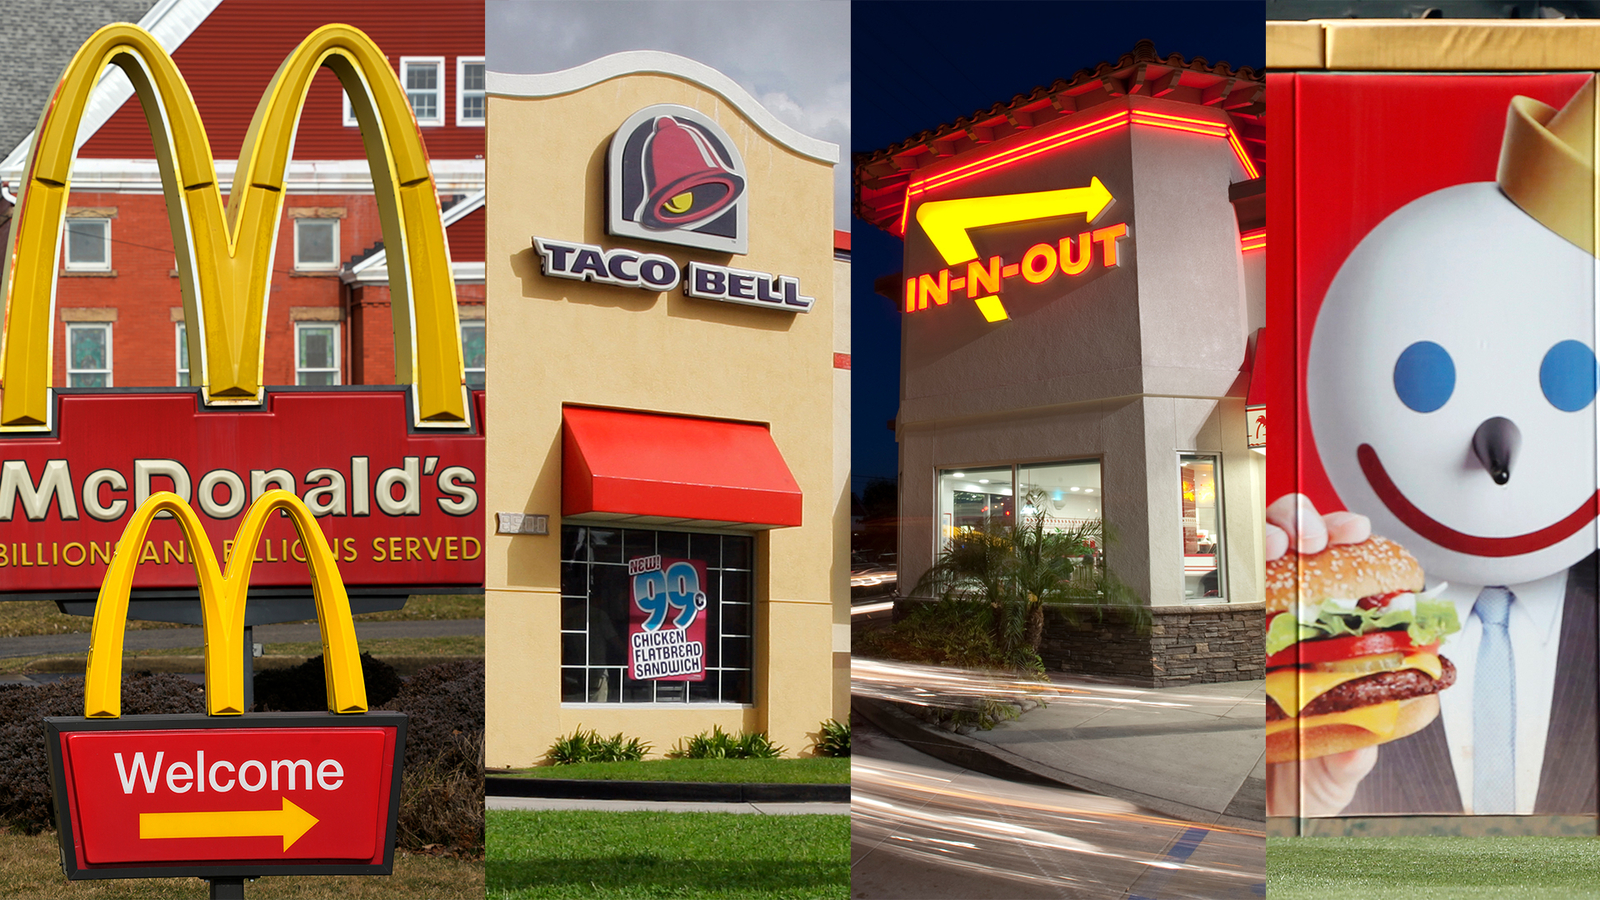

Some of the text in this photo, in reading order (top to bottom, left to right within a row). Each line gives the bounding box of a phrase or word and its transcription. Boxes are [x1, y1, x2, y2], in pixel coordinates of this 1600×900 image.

[543, 244, 814, 307] TACO BELL
[906, 222, 1130, 313] IN-N-OUT
[0, 456, 479, 521] McDonald's
[0, 542, 119, 567] BILLION
[139, 540, 193, 564] AN
[372, 536, 482, 561] SERVED
[630, 555, 660, 574] NEW!
[633, 631, 684, 648] CHICKEN
[635, 643, 701, 662] FLATBREAD
[636, 658, 700, 677] SANDWICH
[113, 750, 344, 795] Welcome
